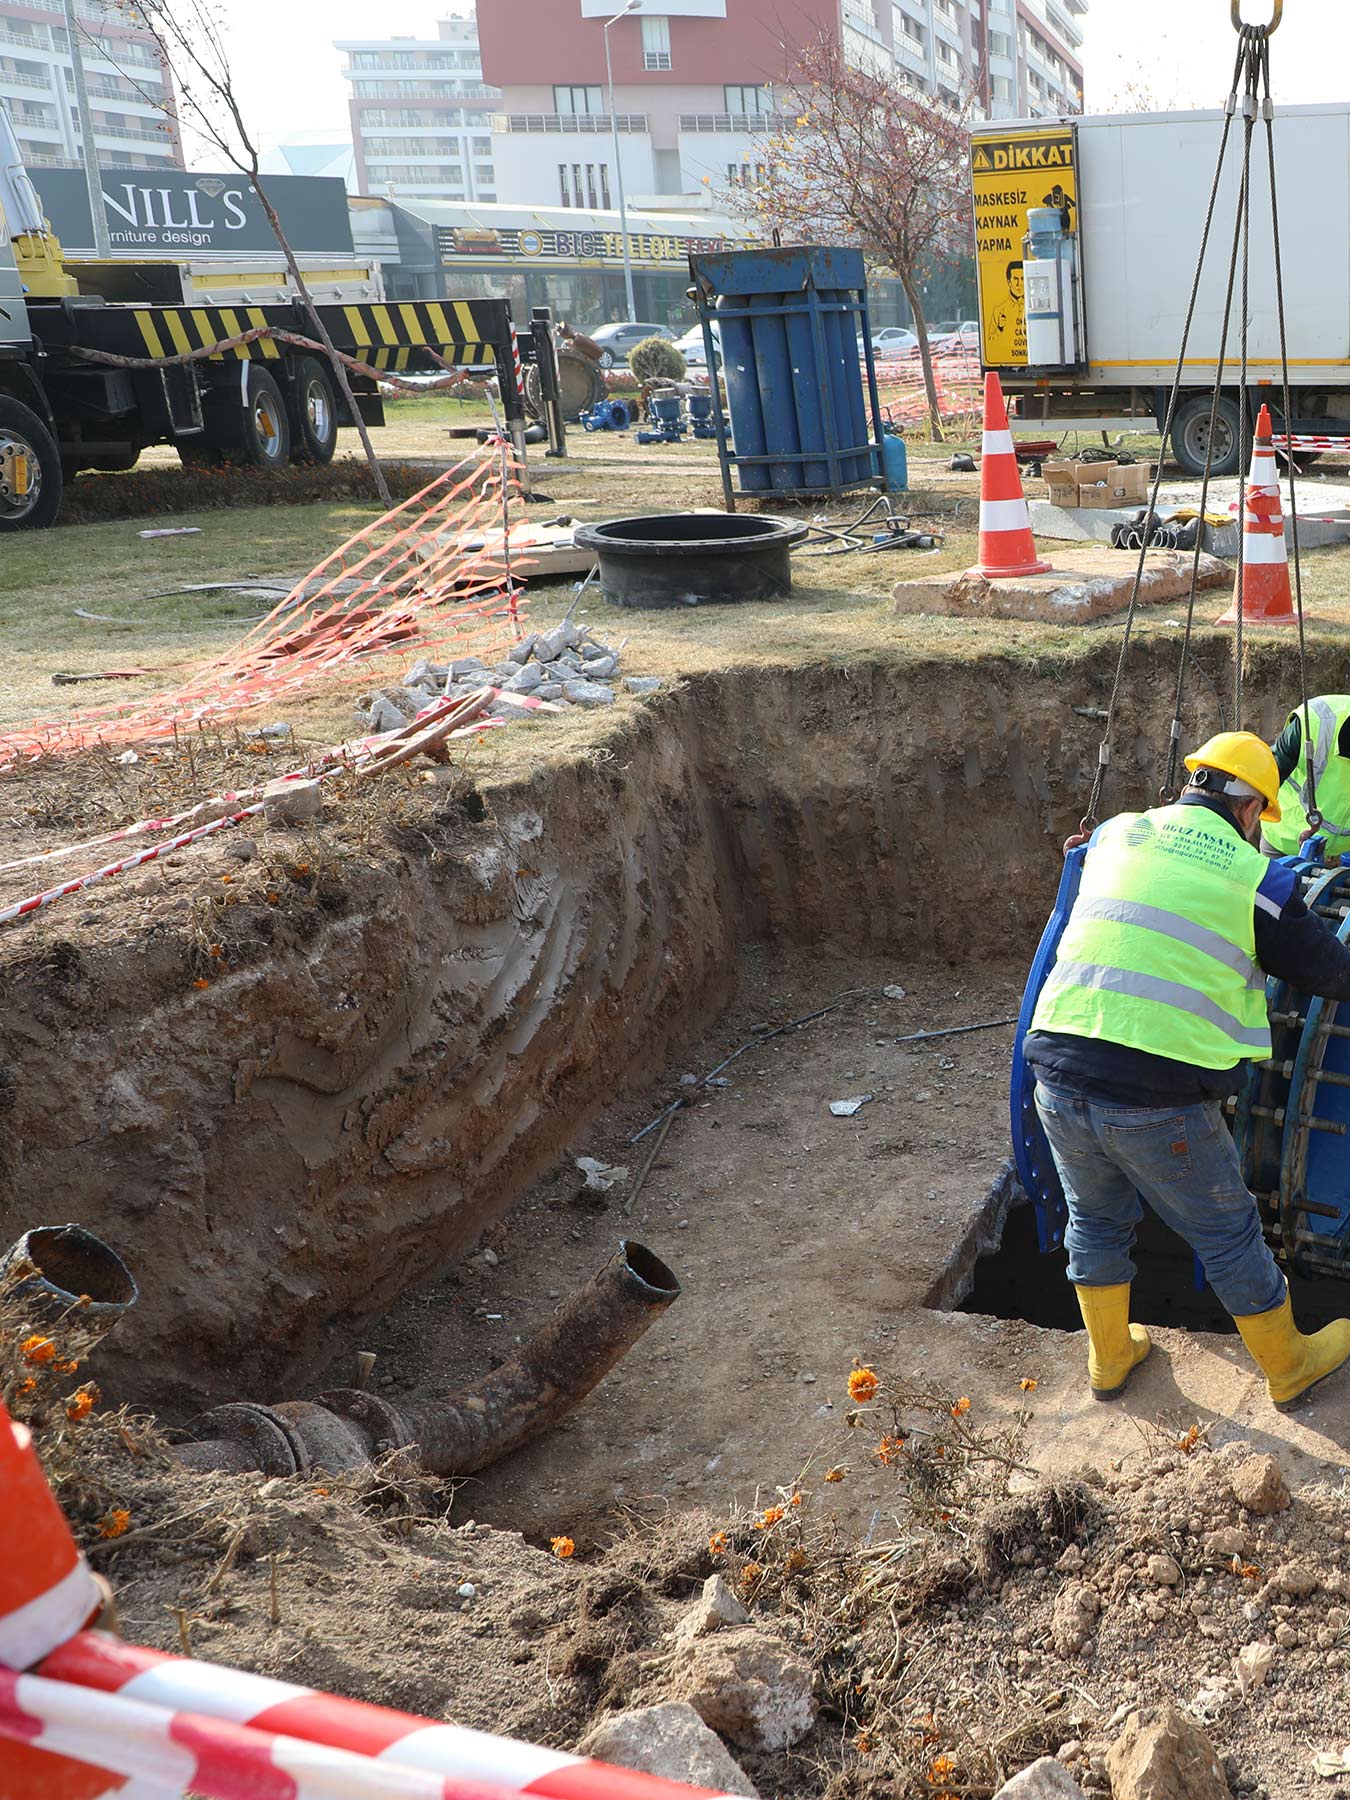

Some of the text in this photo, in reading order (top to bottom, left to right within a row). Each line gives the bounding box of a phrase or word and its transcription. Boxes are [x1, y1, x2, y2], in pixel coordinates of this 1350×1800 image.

[993, 144, 1073, 169] DİKKAT
[974, 188, 1027, 207] MASKESİZ
[976, 215, 1018, 229] KAYNAK
[162, 230, 211, 246] design
[556, 232, 595, 257] BIG
[603, 233, 681, 260] YELLOW
[977, 238, 1012, 252] YAPMA
